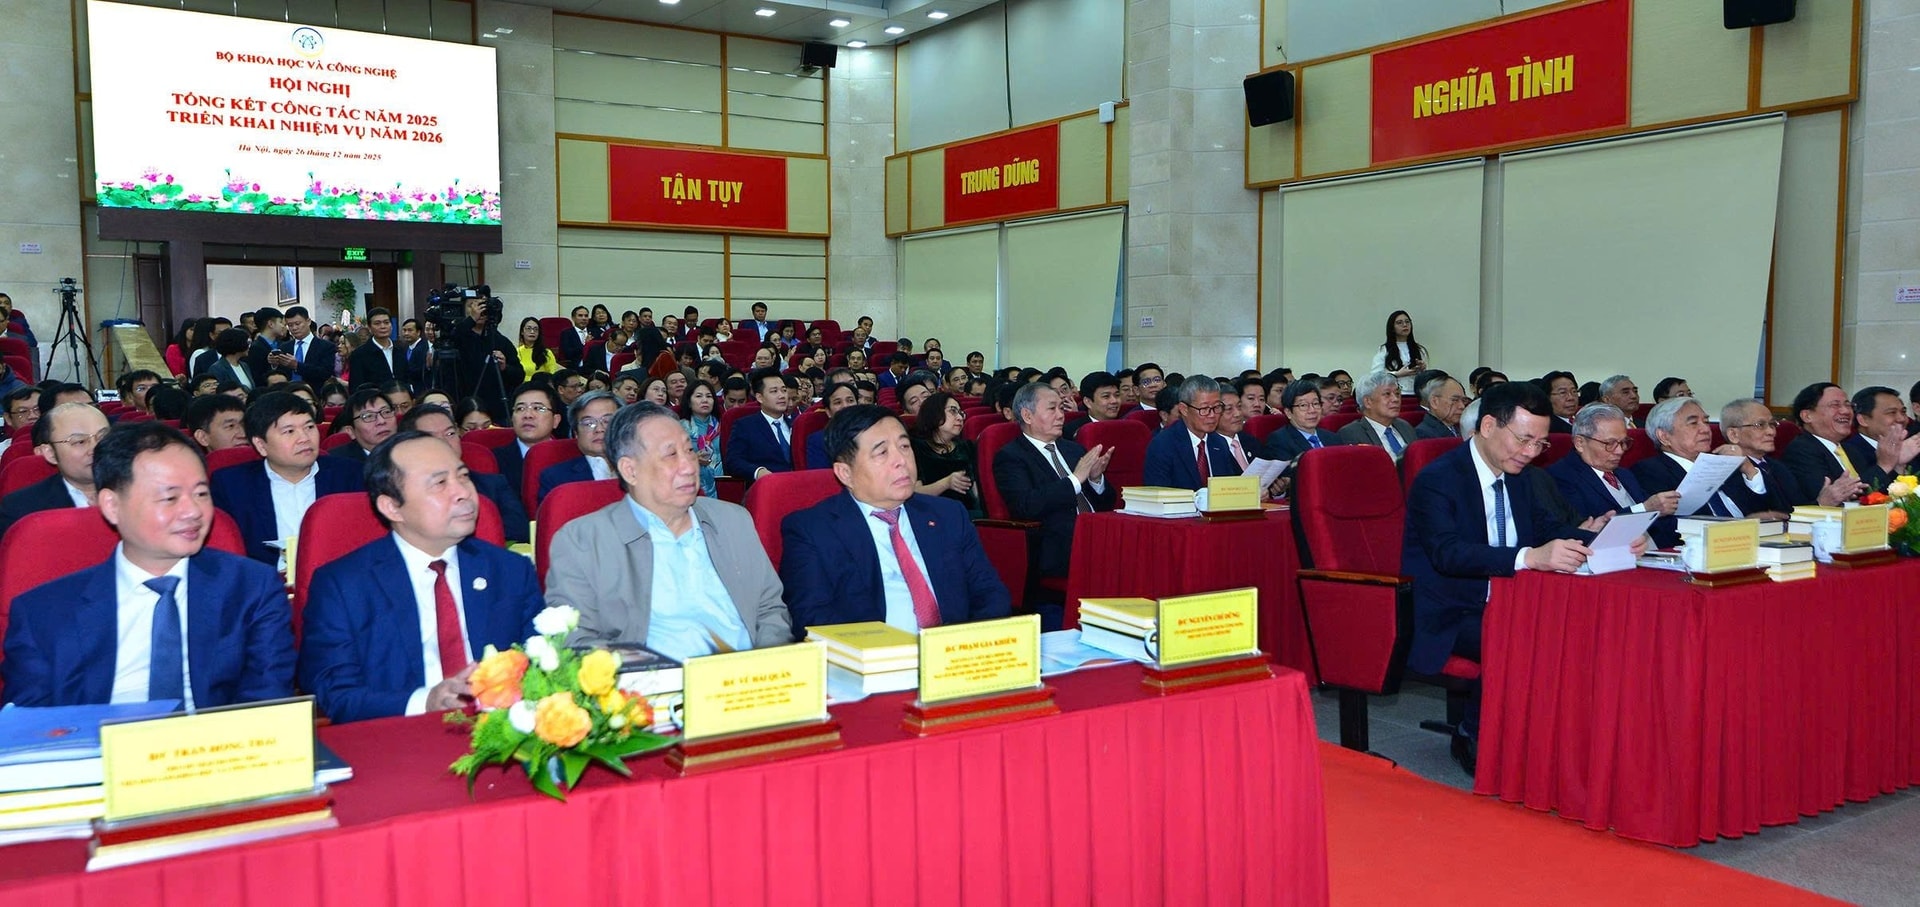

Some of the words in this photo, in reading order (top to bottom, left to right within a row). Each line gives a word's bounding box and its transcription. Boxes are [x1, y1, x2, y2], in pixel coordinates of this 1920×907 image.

[216, 51, 234, 62] BỘ
[237, 53, 274, 65] KHOA
[277, 57, 304, 69] HỌC
[307, 60, 324, 70] VÀ
[326, 62, 361, 75] CÔNG
[364, 66, 397, 79] NGHỆ
[269, 77, 301, 92] HỘI
[307, 81, 350, 98] NGHỊ
[1413, 66, 1496, 119] NGHĨA
[1506, 55, 1574, 102] TÌNH
[171, 92, 225, 109] TỔNG
[230, 96, 267, 112] KẾT
[271, 100, 321, 117] CÔNG
[326, 105, 360, 120] TÁC
[365, 109, 402, 124] NĂM
[407, 114, 438, 127] 2025
[230, 115, 275, 130] KHAI
[280, 120, 338, 136] NHIỆM
[343, 125, 366, 139] VỤ
[371, 126, 407, 141] NĂM
[412, 131, 443, 144] 2026
[660, 172, 702, 205] TẬN
[707, 179, 743, 208] TỤY
[960, 166, 1000, 195] TRUNG
[1003, 157, 1040, 188] DŨNG
